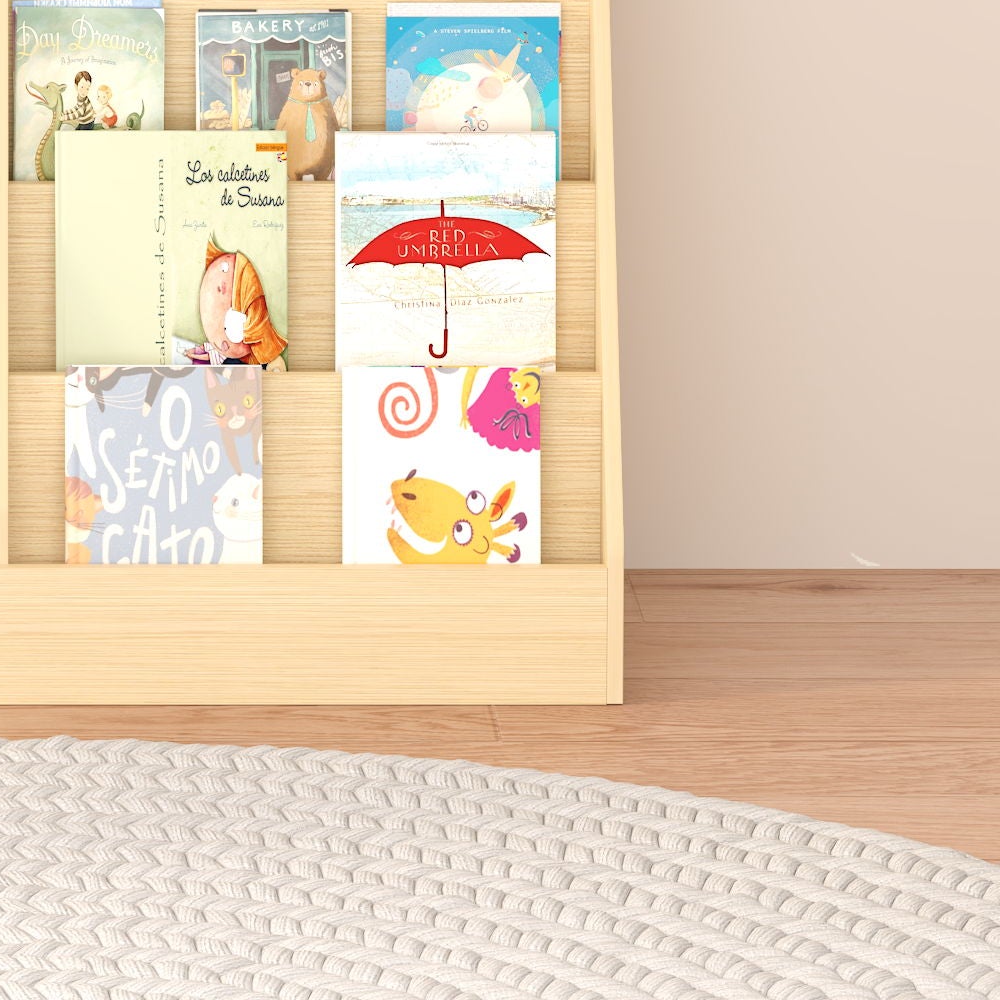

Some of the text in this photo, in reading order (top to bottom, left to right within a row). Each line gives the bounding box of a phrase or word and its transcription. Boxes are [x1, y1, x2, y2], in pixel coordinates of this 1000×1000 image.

[231, 19, 305, 33] BAKERY
[16, 14, 158, 64] Day Dreamers
[186, 160, 270, 186] Los calcetines
[154, 158, 167, 237] Susana
[220, 186, 285, 208] de Susana
[438, 220, 455, 228] THE
[429, 229, 466, 243] RED
[155, 243, 165, 265] de
[397, 243, 500, 260] UMBRELLA
[394, 300, 441, 309] Christina
[160, 385, 192, 451] O
